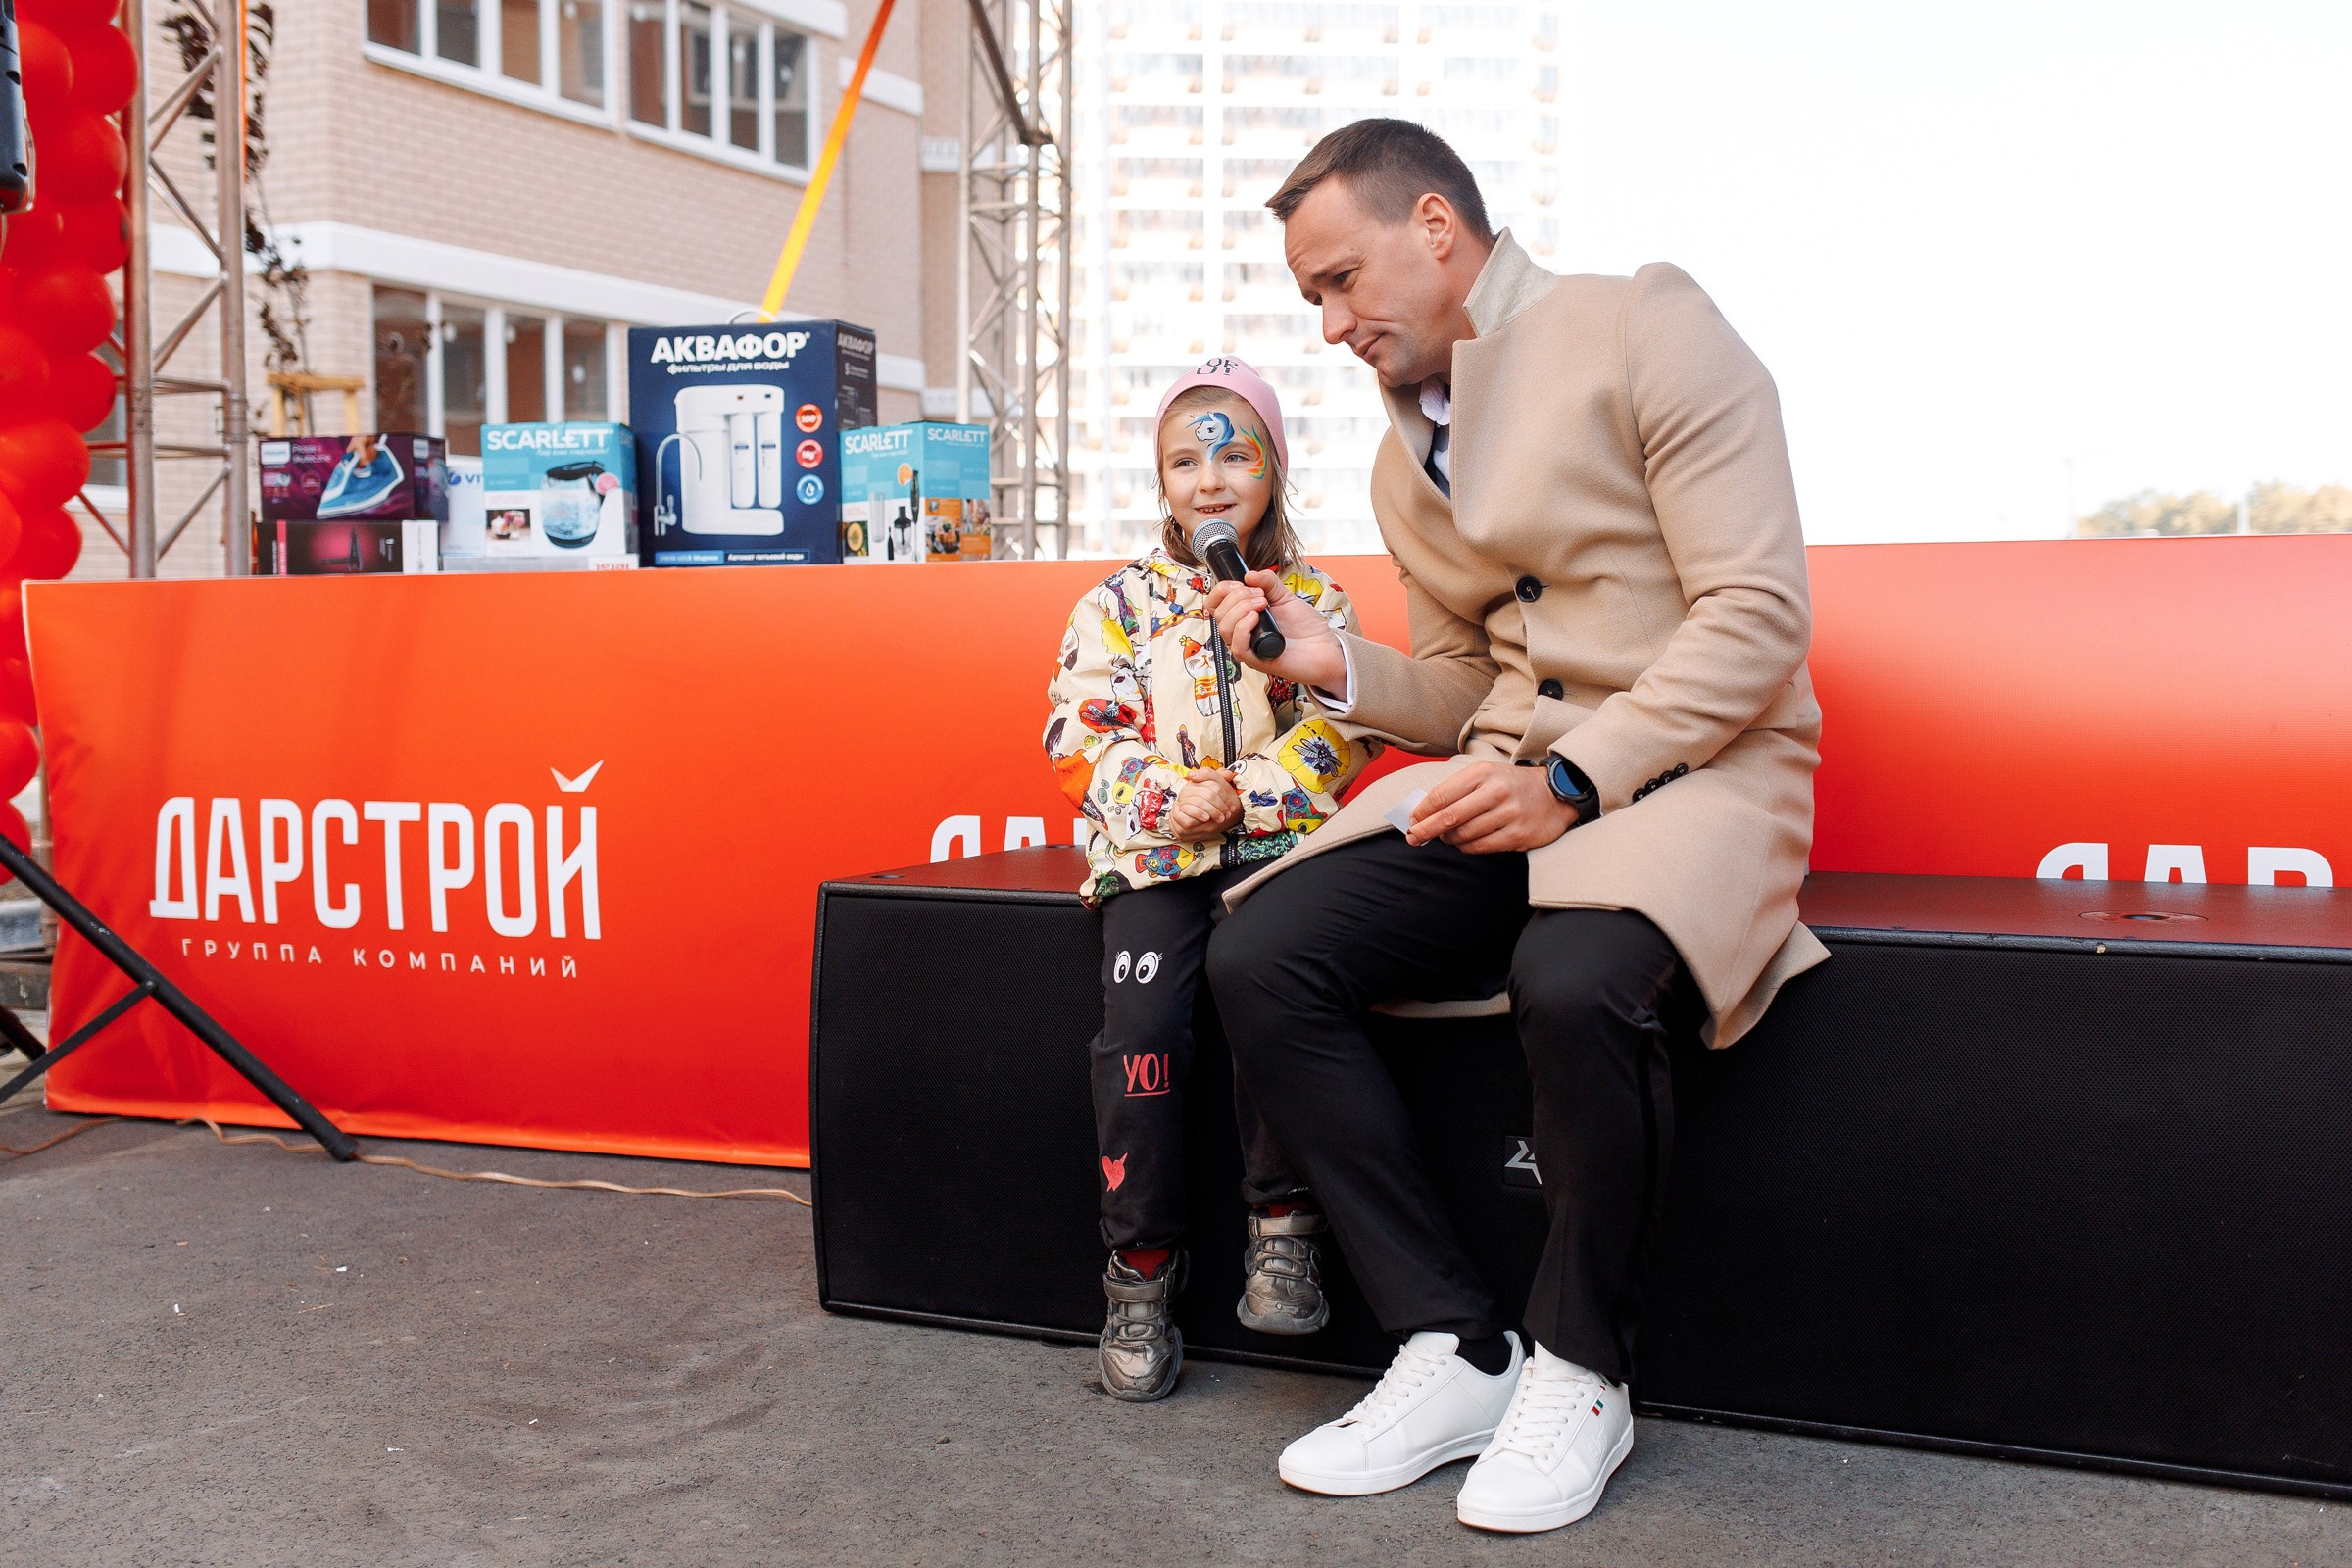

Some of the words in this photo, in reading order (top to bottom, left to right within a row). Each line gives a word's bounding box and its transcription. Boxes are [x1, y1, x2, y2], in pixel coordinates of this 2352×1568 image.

[651, 331, 807, 364] АКВАФОР
[667, 363, 726, 375] фильтры
[727, 362, 753, 373] для
[754, 361, 790, 372] воды
[487, 428, 611, 450] SCARLETT
[845, 430, 911, 454] SCARLETT
[927, 428, 988, 443] SCARLETT
[150, 760, 603, 940] ДАРСТРОЙ
[182, 938, 321, 964] ГРУППА
[353, 948, 577, 978] КОМПАНИЙ
[1123, 1053, 1169, 1093] YO!
